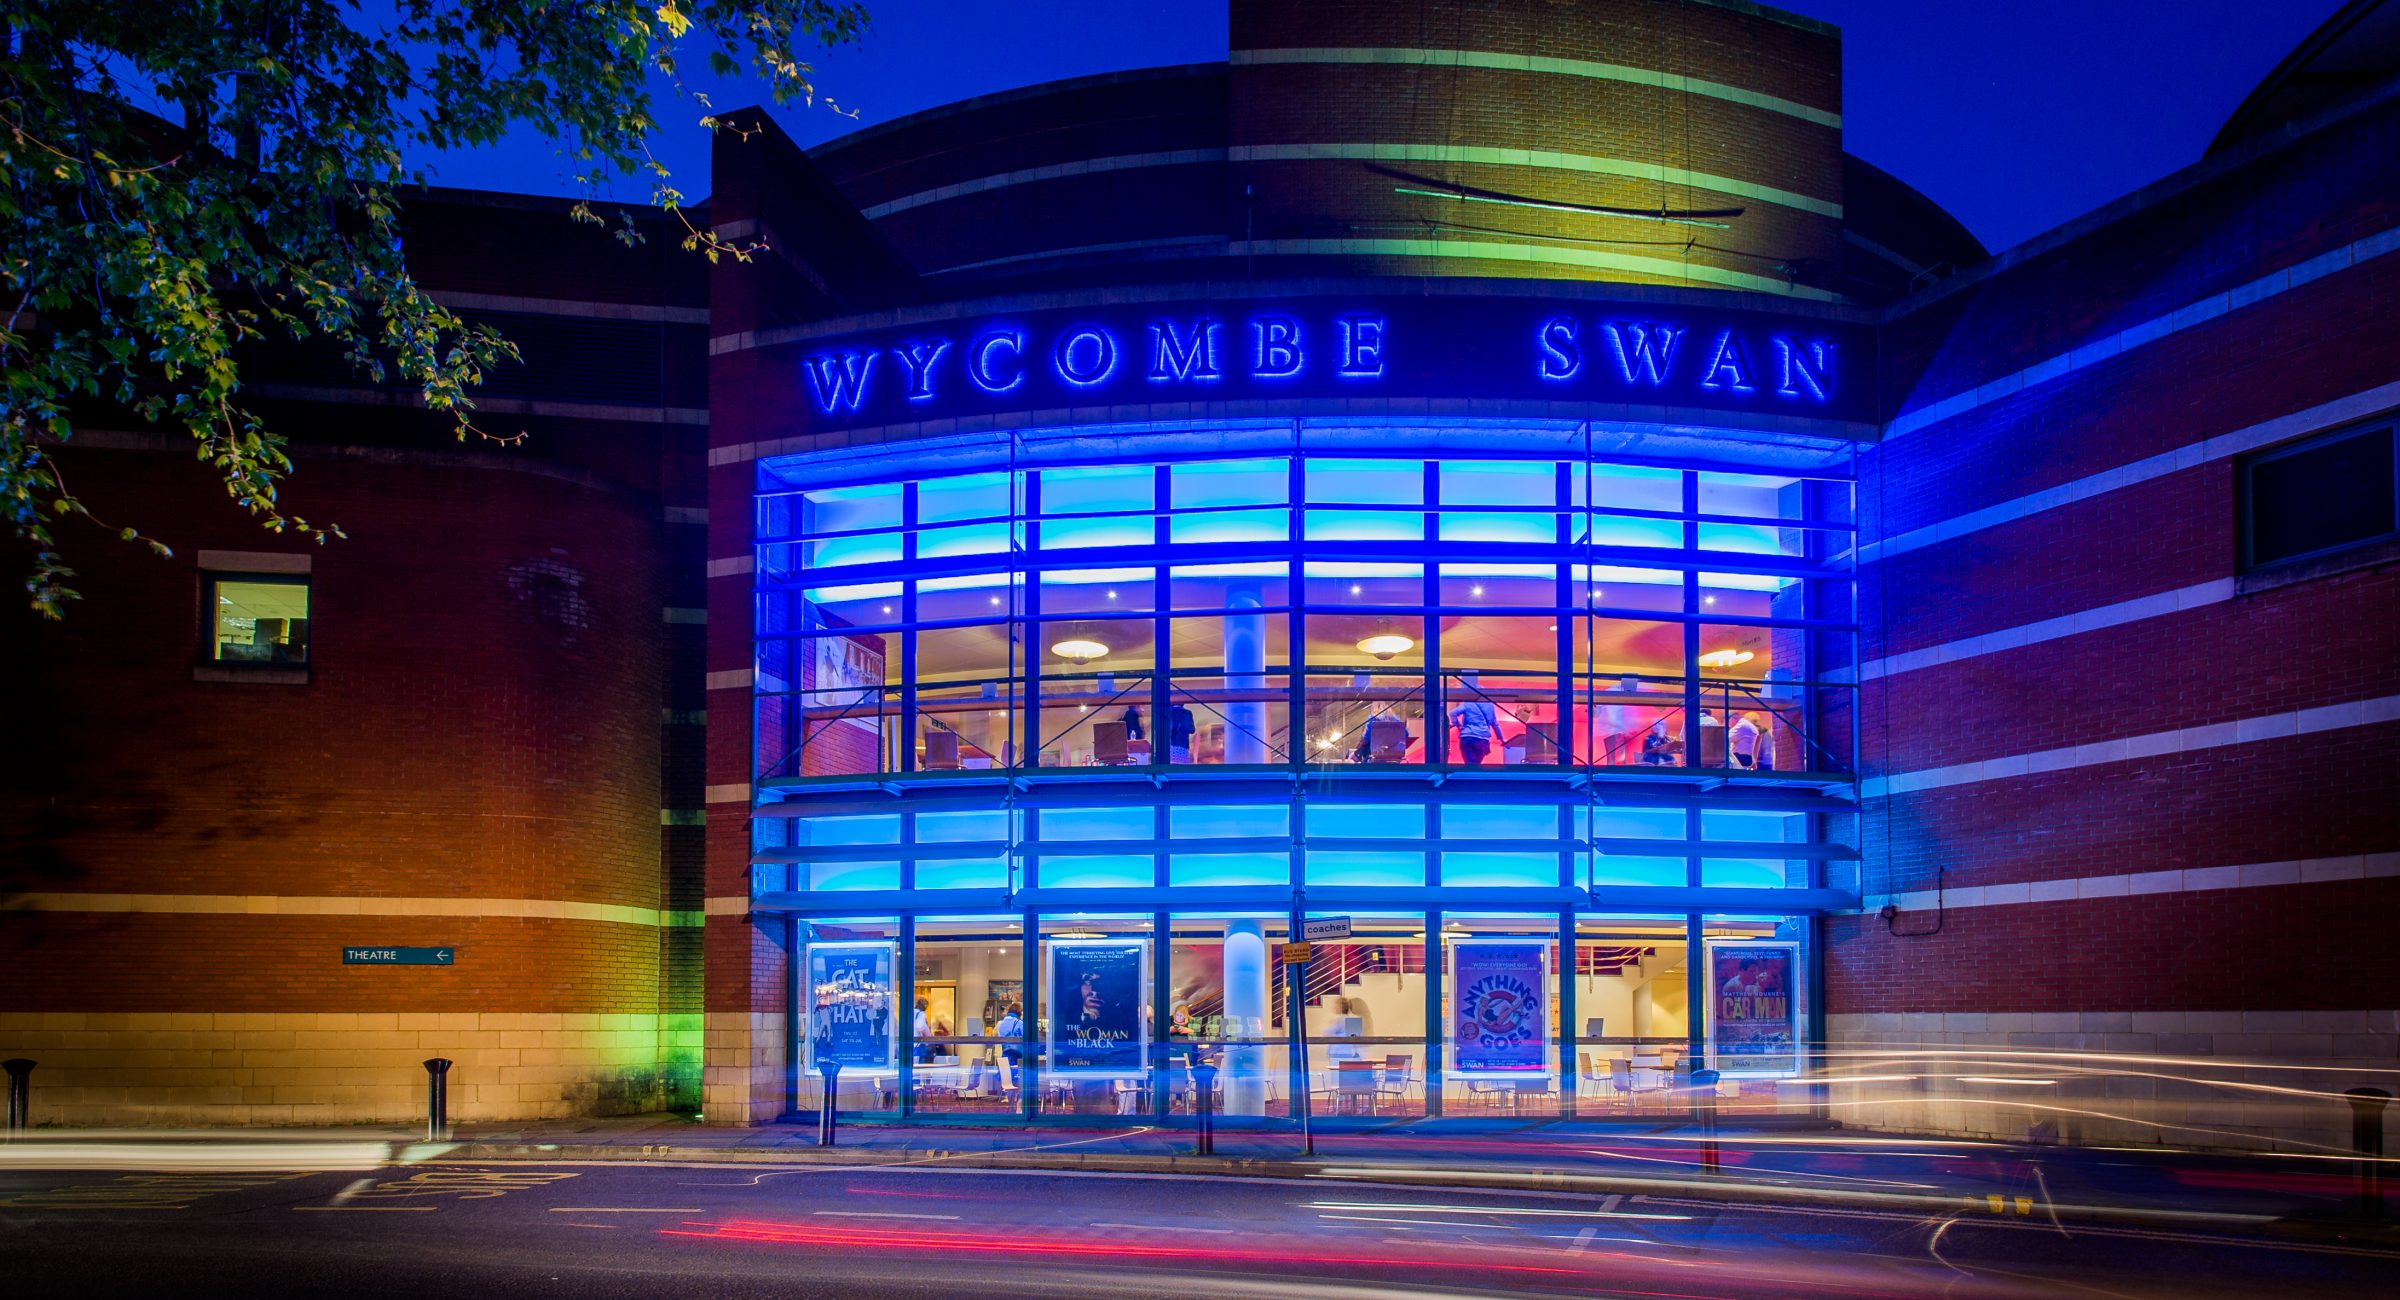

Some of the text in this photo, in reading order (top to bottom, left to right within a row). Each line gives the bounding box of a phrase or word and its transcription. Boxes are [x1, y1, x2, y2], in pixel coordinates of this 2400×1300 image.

[803, 314, 1836, 411] WYCOMBE SWAN
[1307, 923, 1347, 934] coaches
[348, 950, 397, 960] THEATRE
[844, 959, 858, 967] THE
[832, 968, 869, 990] CAT
[1461, 975, 1538, 1019] ANYTHING
[833, 1005, 868, 1024] HAT
[1723, 997, 1786, 1018] CAR MAN
[1076, 1026, 1129, 1041] WOMAN
[1076, 1038, 1114, 1048] BLACK
[1480, 1026, 1532, 1051] GOES
